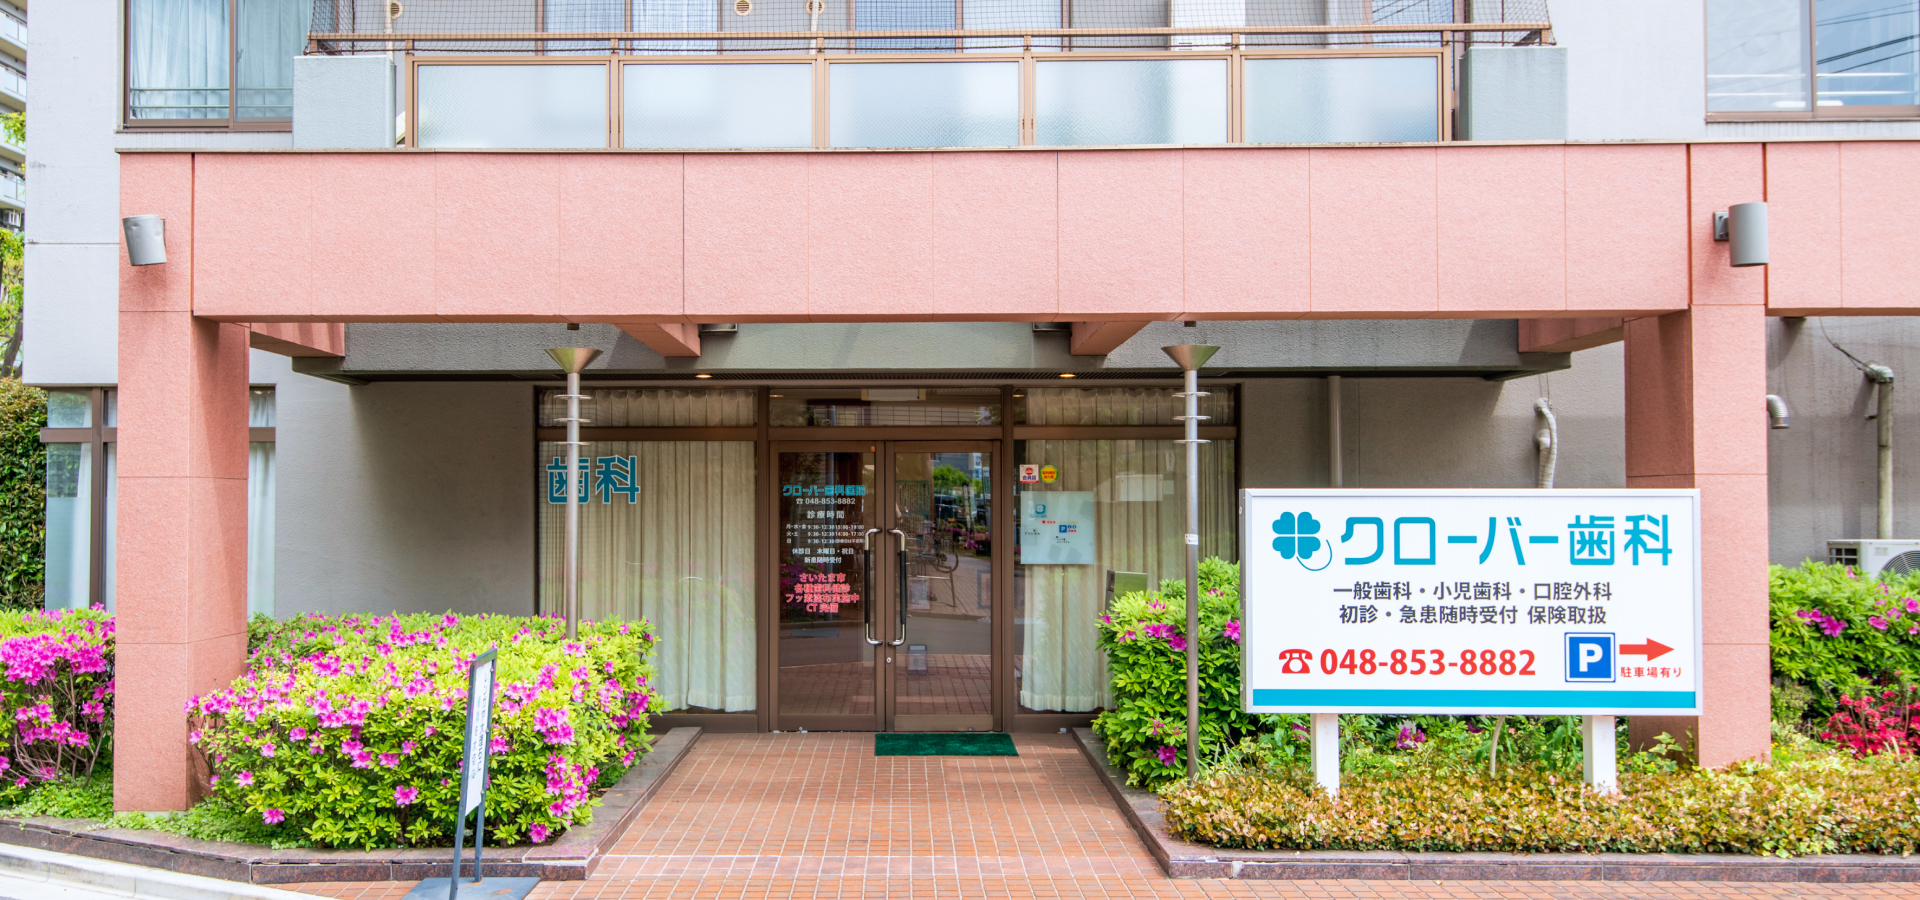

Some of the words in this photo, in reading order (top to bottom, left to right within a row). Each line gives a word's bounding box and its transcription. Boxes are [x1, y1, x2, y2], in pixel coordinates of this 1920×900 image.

[546, 455, 640, 504] 歯科
[783, 485, 866, 496] クローバー歯科医院
[807, 511, 845, 519] 診療時間
[1340, 513, 1673, 567] クローバー歯科
[804, 556, 842, 564] 新患随時受付
[799, 573, 846, 583] さいたま市
[794, 583, 851, 593] 各種歯科健診
[1333, 581, 1613, 602] 一般歯科・小児歯科・口腔外科
[785, 593, 860, 603] フッ素塗布実施中
[806, 603, 818, 613] CT
[819, 603, 839, 613] 完備
[1338, 605, 1518, 625] 初診・急患随時受付
[1527, 605, 1607, 625] 保険取扱
[1320, 648, 1536, 677] 048-853-8882
[1577, 643, 1604, 672] P
[1619, 666, 1682, 679] 駐車場有り
